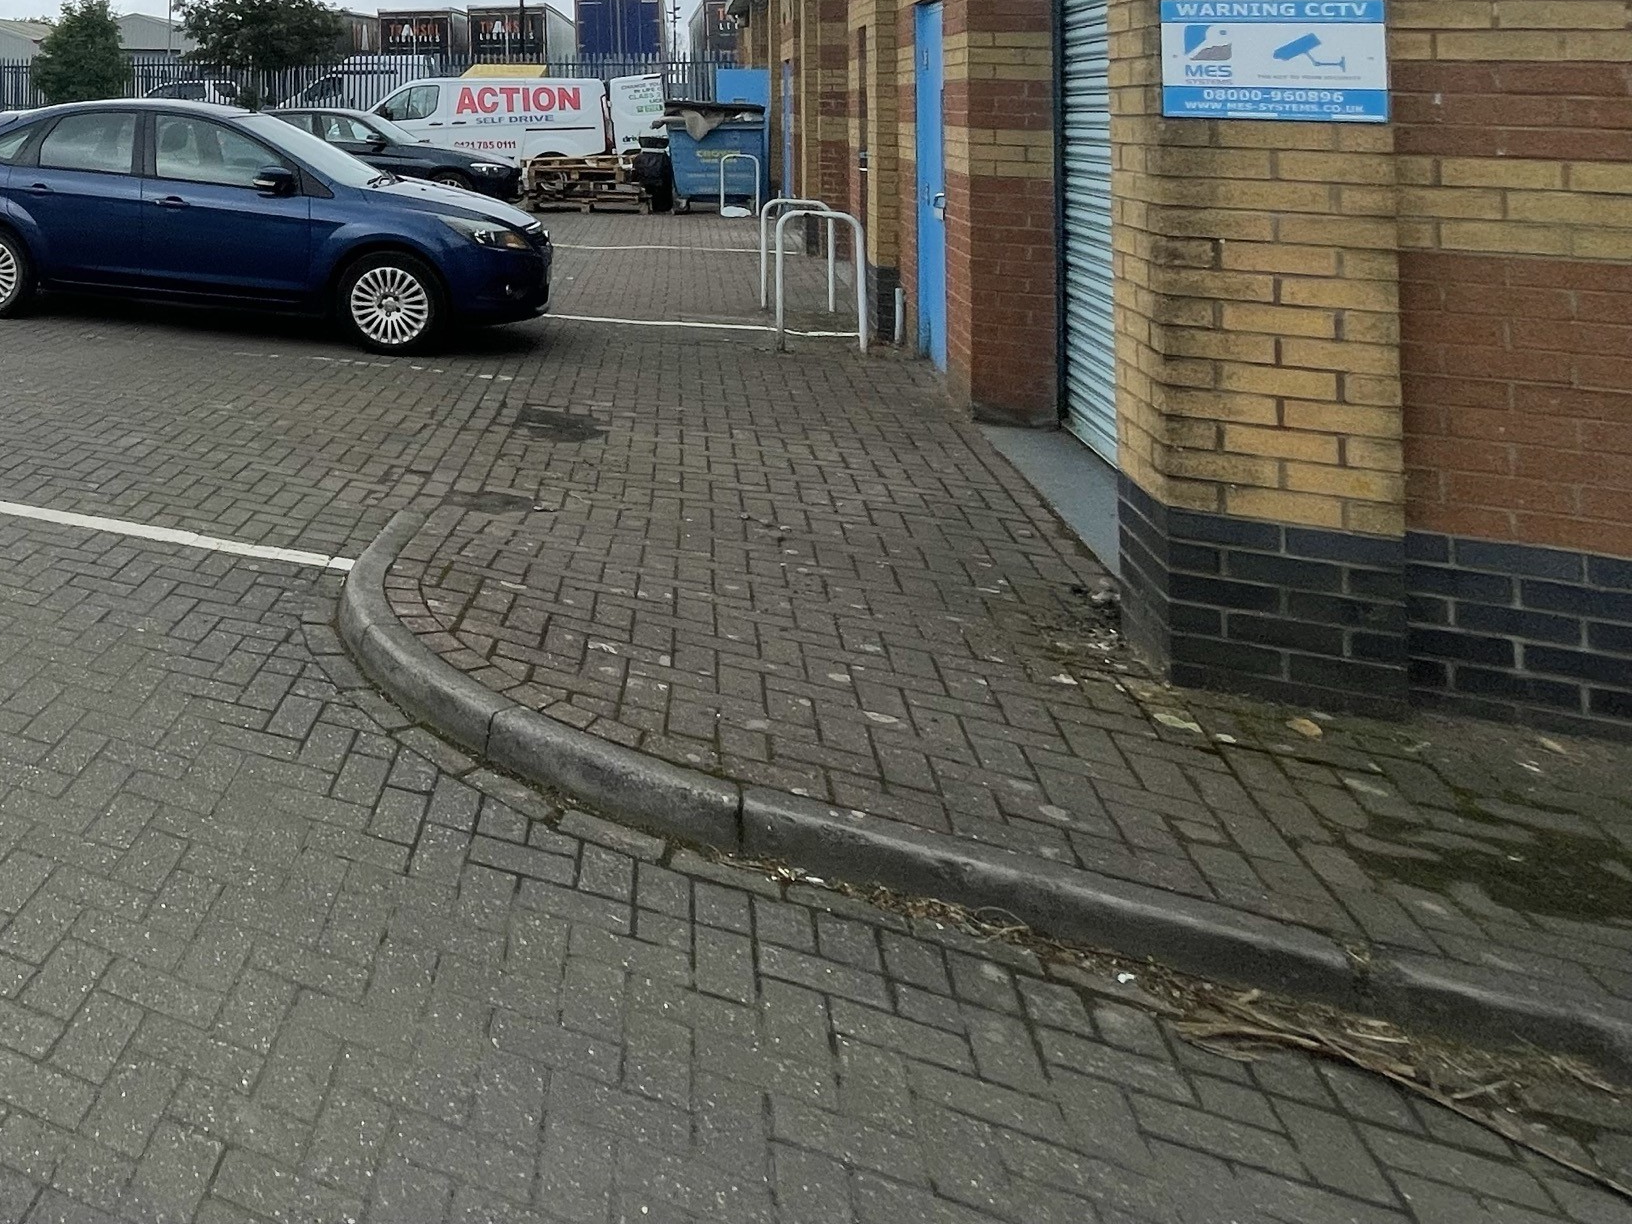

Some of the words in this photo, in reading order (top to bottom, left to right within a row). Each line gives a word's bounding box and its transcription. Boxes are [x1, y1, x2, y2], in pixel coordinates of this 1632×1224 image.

[1175, 2, 1296, 17] WARNING
[1304, 2, 1368, 17] CCTV
[1184, 64, 1233, 78] MES
[455, 86, 582, 115] ACTION
[1203, 89, 1345, 103] 08000-960896
[475, 116, 506, 125] SELF
[508, 114, 555, 123] DRIVE
[476, 140, 494, 149] 785
[496, 140, 517, 149] 0111
